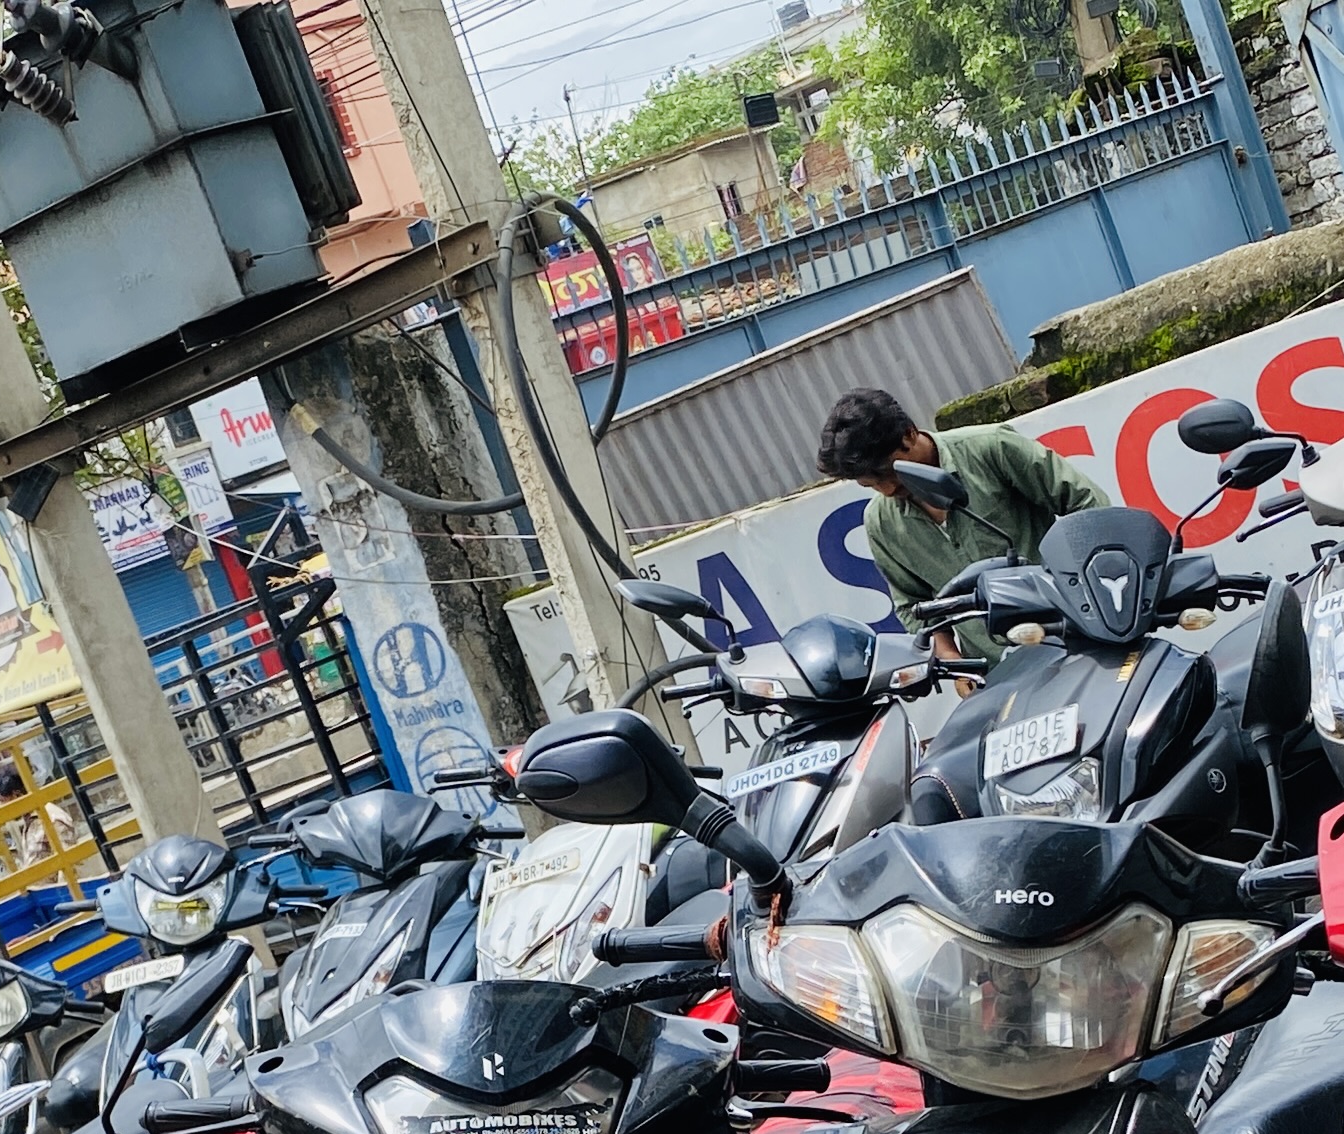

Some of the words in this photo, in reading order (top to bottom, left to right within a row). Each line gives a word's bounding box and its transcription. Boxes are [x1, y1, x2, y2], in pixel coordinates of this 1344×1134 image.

[393, 698, 465, 728] Mahindra
[994, 888, 1055, 907] Hero
[429, 1113, 578, 1134] AUTOMOBIKES
